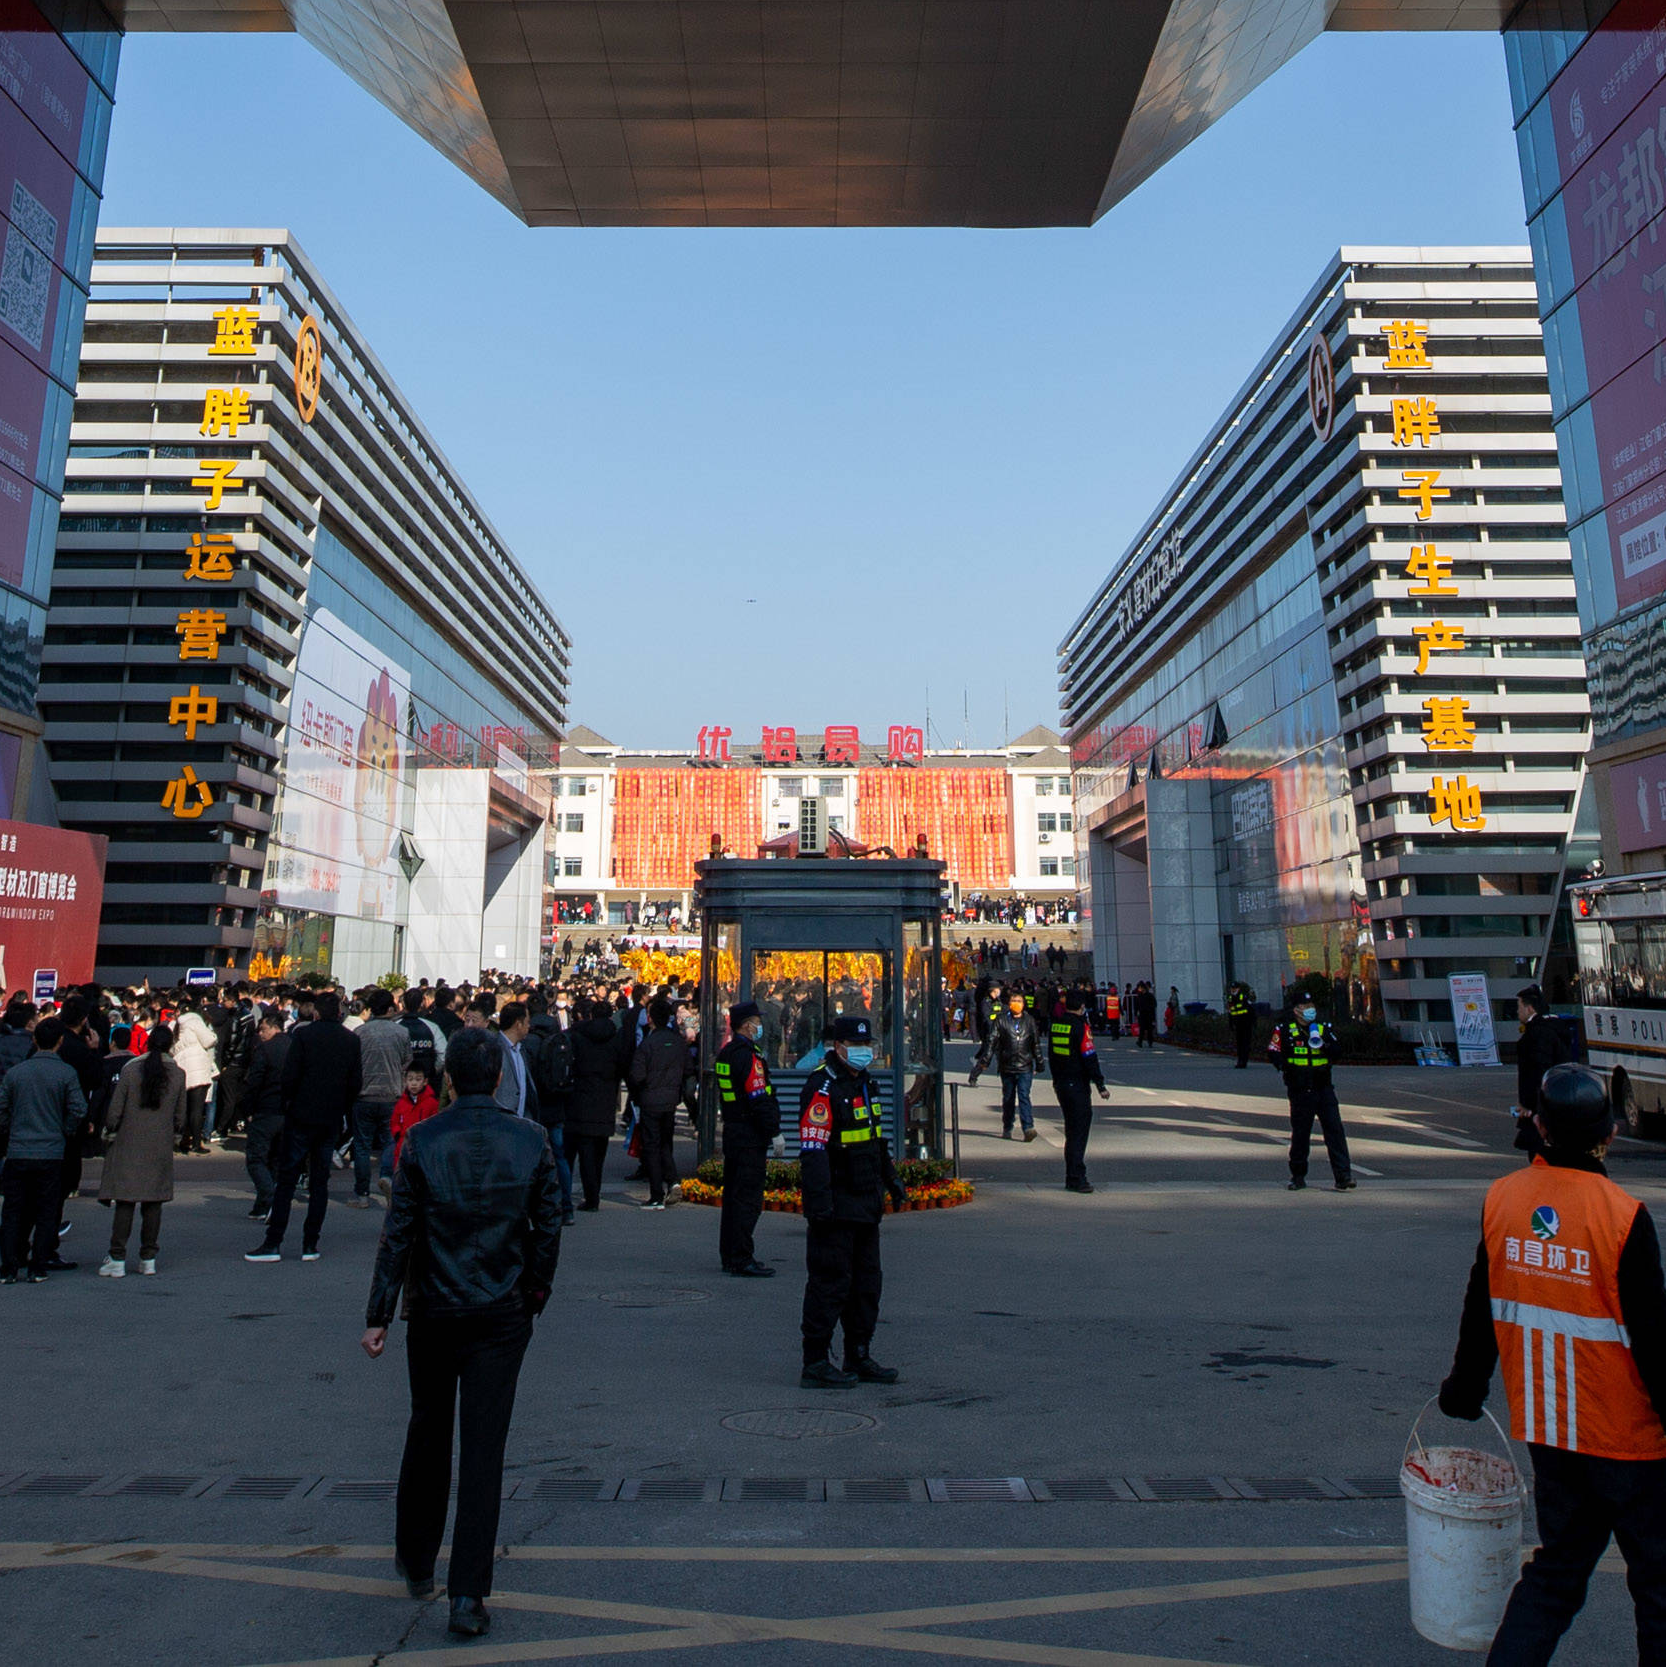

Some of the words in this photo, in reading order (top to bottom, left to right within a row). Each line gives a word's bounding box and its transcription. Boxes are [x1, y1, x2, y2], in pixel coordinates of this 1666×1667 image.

[160, 305, 260, 820] 蓝胖子运营中心
[1380, 320, 1487, 833] 蓝胖子生产基地
[697, 725, 924, 763] 优铝易购
[38, 908, 55, 922] EXPO
[1505, 1237, 1591, 1276] 南昌环卫
